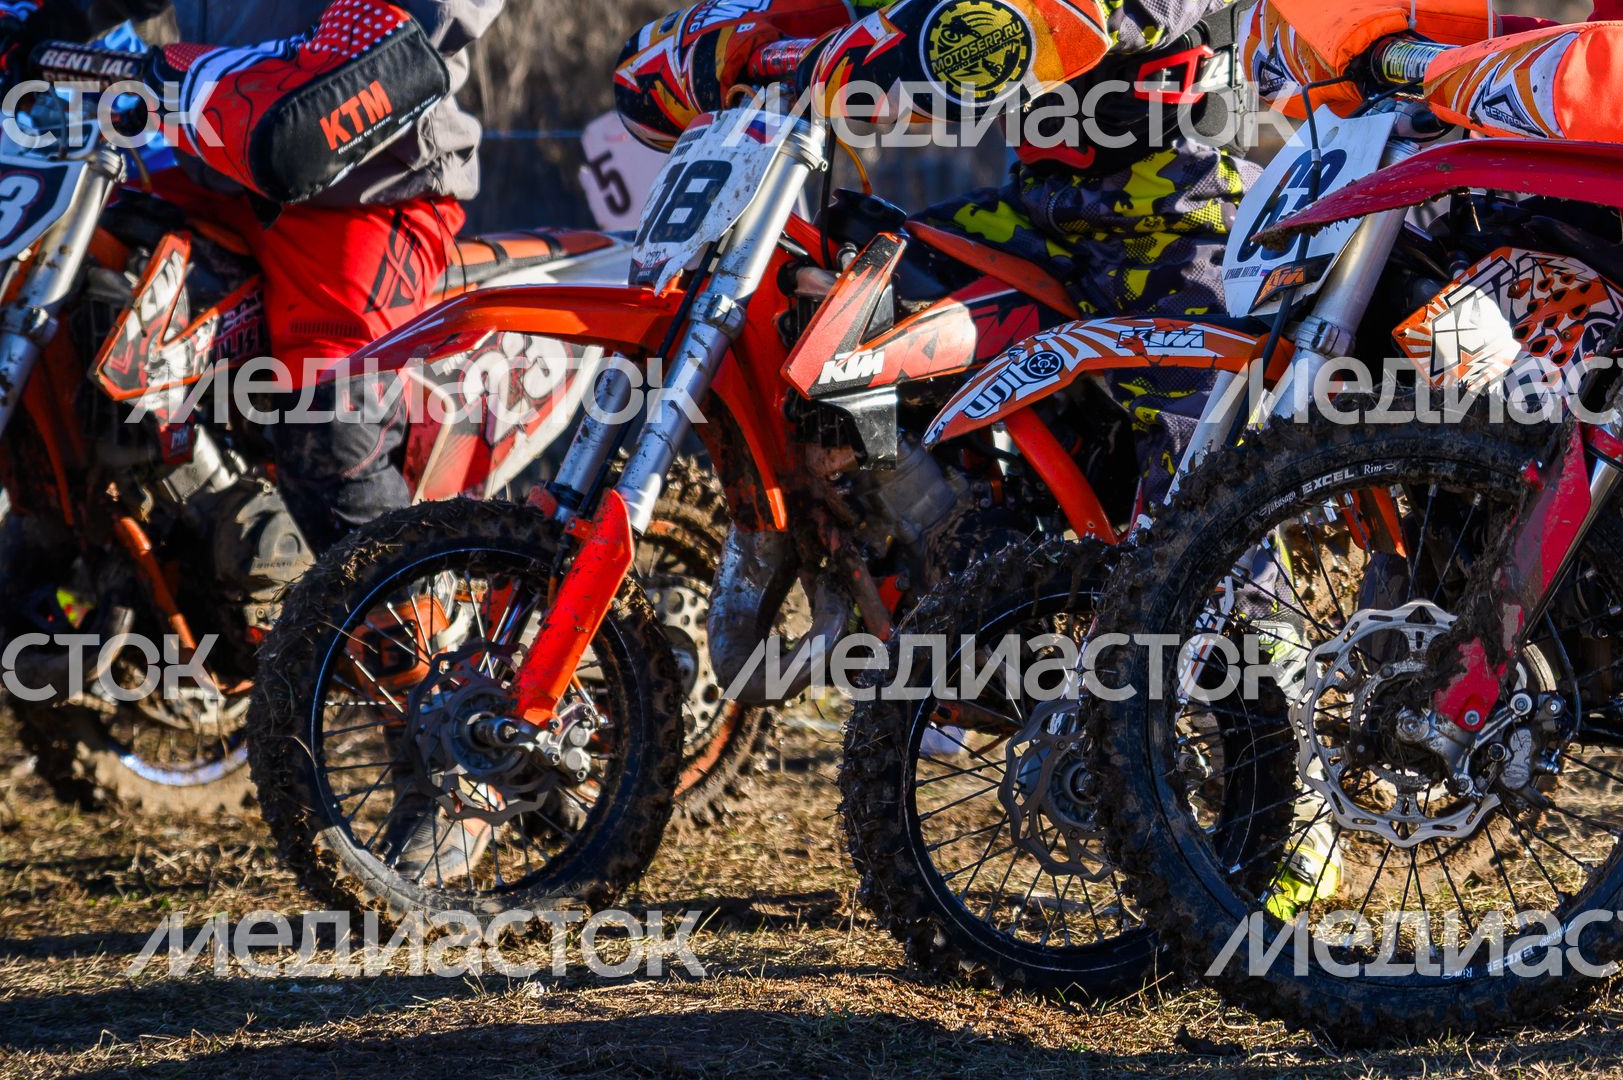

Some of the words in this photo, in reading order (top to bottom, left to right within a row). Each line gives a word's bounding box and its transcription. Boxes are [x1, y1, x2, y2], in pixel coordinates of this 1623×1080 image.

[932, 21, 1023, 73] MOTOSERP.RU
[320, 80, 393, 151] KTM
[588, 149, 631, 218] 5
[818, 348, 885, 385] KTM
[1301, 467, 1355, 495] EXCEL
